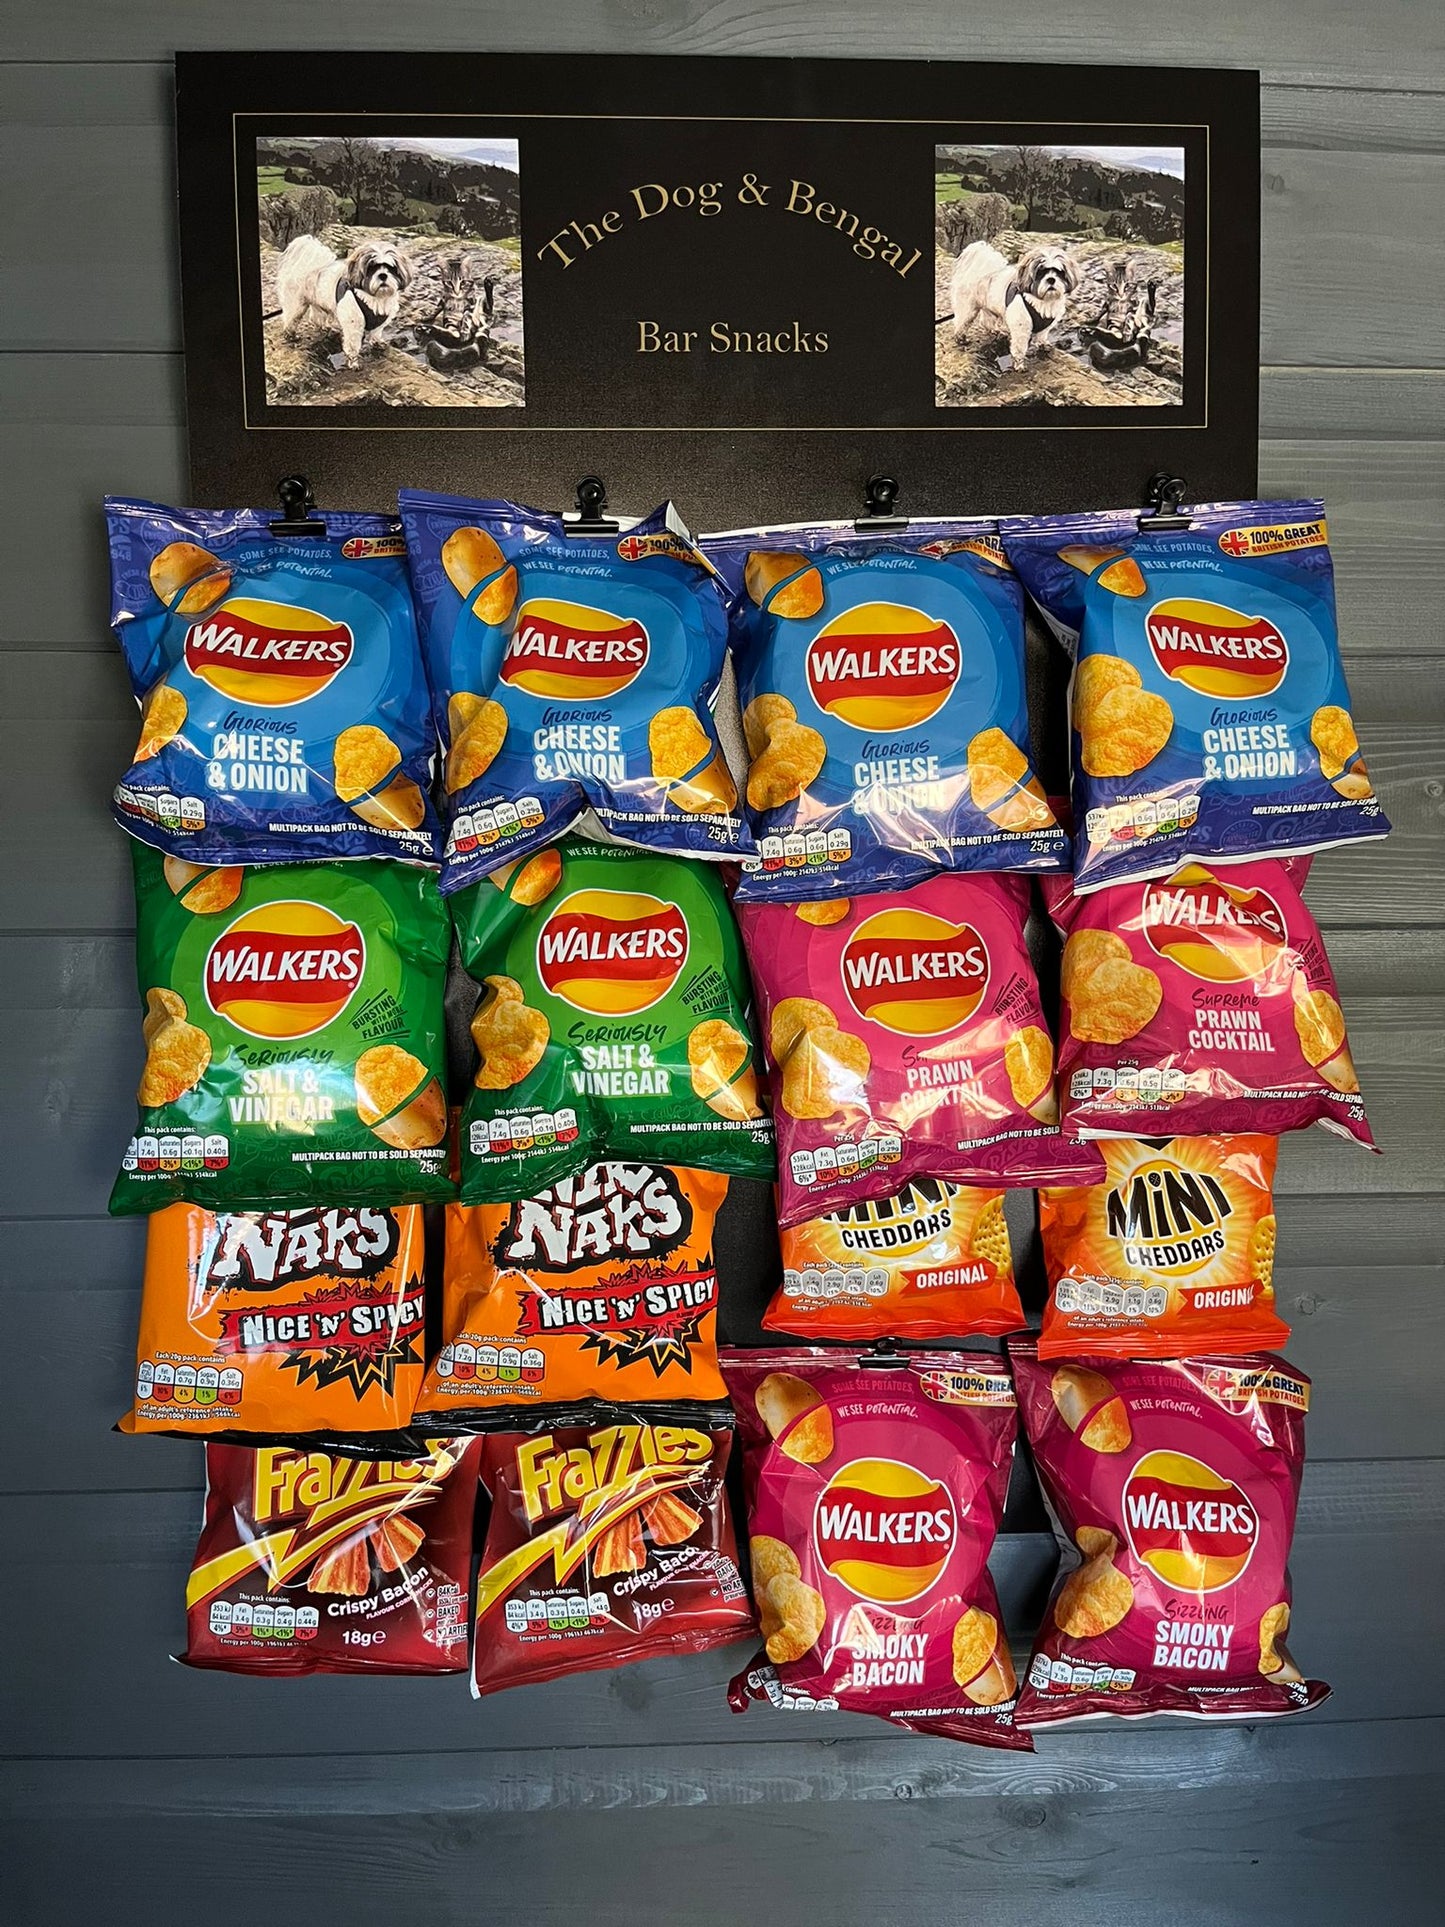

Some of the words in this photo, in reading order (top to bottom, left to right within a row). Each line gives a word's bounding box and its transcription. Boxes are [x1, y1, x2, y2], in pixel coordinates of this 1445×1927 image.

[537, 210, 624, 270] The
[629, 181, 723, 217] Dog
[737, 173, 771, 206] &
[784, 179, 922, 279] Bengal
[637, 321, 698, 353] Bar
[710, 321, 828, 353] Snacks
[1250, 529, 1283, 545] 100%
[1283, 524, 1321, 541] GREAT
[1251, 541, 1284, 552] BRITISH
[1285, 534, 1325, 548] POTATOES
[546, 546, 562, 558] SEE
[565, 549, 610, 560] POTATOES,
[523, 561, 538, 570] WE
[539, 560, 555, 571] SEE
[557, 565, 613, 577] POTENTIAL.
[192, 622, 348, 663] WALKERS
[504, 627, 644, 663] WALKERS
[1150, 624, 1283, 660] WALKERS
[811, 644, 956, 683] WALKERS
[213, 732, 304, 764] CHEESE
[533, 725, 620, 752] CHEESE
[1203, 724, 1290, 753] CHEESE
[208, 763, 226, 789] &
[229, 765, 308, 793] ONION
[534, 755, 553, 780] &
[556, 753, 626, 781] ONION
[854, 755, 939, 787] CHEESE
[1204, 756, 1222, 779] &
[1225, 750, 1296, 779] ONION
[1358, 805, 1378, 817] 25g
[269, 823, 313, 832] MULTIPACK
[314, 823, 330, 832] BAG
[331, 823, 346, 831] NOT
[388, 830, 432, 840] SEPARATELY
[707, 825, 728, 844] 25g
[951, 837, 966, 846] BAG
[967, 836, 982, 845] NOT
[983, 835, 992, 844] TO
[993, 834, 1001, 842] BE
[1003, 832, 1021, 841] SOLD
[1022, 829, 1064, 839] SEPARATELY
[399, 841, 420, 854] 25g
[1030, 840, 1050, 853] 25g
[543, 927, 684, 965] WALKERS
[211, 945, 360, 983] WALKERS
[846, 946, 985, 990] WALKERS
[682, 969, 722, 1006] BURSTING
[994, 977, 1029, 1016] BURSTING
[352, 994, 397, 1030] BURSTING
[691, 992, 730, 1015] FLAVOUR
[361, 1016, 406, 1039] FLAVOUR
[1195, 1009, 1261, 1030] PRAWN
[1189, 1029, 1276, 1053] COCKTAIL
[582, 1044, 634, 1070] SALT
[639, 1043, 655, 1068] &
[242, 1069, 301, 1095] SALT
[302, 1068, 319, 1092] &
[572, 1071, 669, 1096] VINEGAR
[906, 1060, 975, 1089] PRAWN
[229, 1096, 335, 1124] VINEGAR
[1347, 1106, 1365, 1121] 25g
[630, 1123, 671, 1133] MULTIPACK
[672, 1122, 686, 1132] BAG
[687, 1122, 702, 1131] NOT
[703, 1122, 712, 1130] TO
[712, 1121, 721, 1130] BE
[722, 1120, 741, 1130] SOLD
[751, 1131, 770, 1145] 25g
[957, 1136, 995, 1151] MULTIPACK
[995, 1132, 1008, 1145] BAG
[1009, 1130, 1024, 1139] NOT
[1024, 1128, 1033, 1138] TO
[1034, 1127, 1043, 1137] BE
[1043, 1125, 1060, 1135] SOLD
[207, 1148, 226, 1156] 0.40g
[292, 1151, 334, 1162] MULTIPACK
[335, 1152, 351, 1161] BAG
[352, 1152, 368, 1161] NOT
[369, 1151, 378, 1160] TO
[379, 1151, 388, 1160] BE
[389, 1151, 408, 1160] SOLD
[507, 1176, 682, 1265] NAKS
[842, 1208, 952, 1249] CHEDDARS
[209, 1208, 390, 1282] NAKS
[1125, 1230, 1225, 1266] CHEDDARS
[916, 1263, 989, 1289] ORIGINAL
[540, 1297, 609, 1329] NICE
[645, 1275, 715, 1315] SPICY
[241, 1313, 311, 1347] NICE
[351, 1296, 424, 1335] SPICY
[950, 1376, 984, 1391] 100%
[985, 1378, 1013, 1391] GREA
[1273, 1378, 1304, 1395] GREAT
[837, 1405, 850, 1418] WE
[850, 1404, 865, 1416] SEE
[866, 1403, 919, 1418] POTENTIAL.
[1130, 1399, 1141, 1410] WE
[1141, 1399, 1154, 1410] SEE
[1155, 1399, 1203, 1419] POTENTIAL.
[1269, 1390, 1305, 1405] POTATOES
[820, 1502, 951, 1543] WALKERS
[1127, 1492, 1253, 1534] WALKERS
[614, 1568, 659, 1596] Crispy
[659, 1546, 700, 1573] Baco
[328, 1592, 380, 1618] Crispy
[382, 1566, 429, 1602] Bacon
[852, 1633, 928, 1660] SMOKY
[1155, 1620, 1235, 1649] SMOKY
[1153, 1647, 1230, 1671] BACON
[853, 1660, 925, 1686] BACON
[994, 1713, 1013, 1726] 25g
